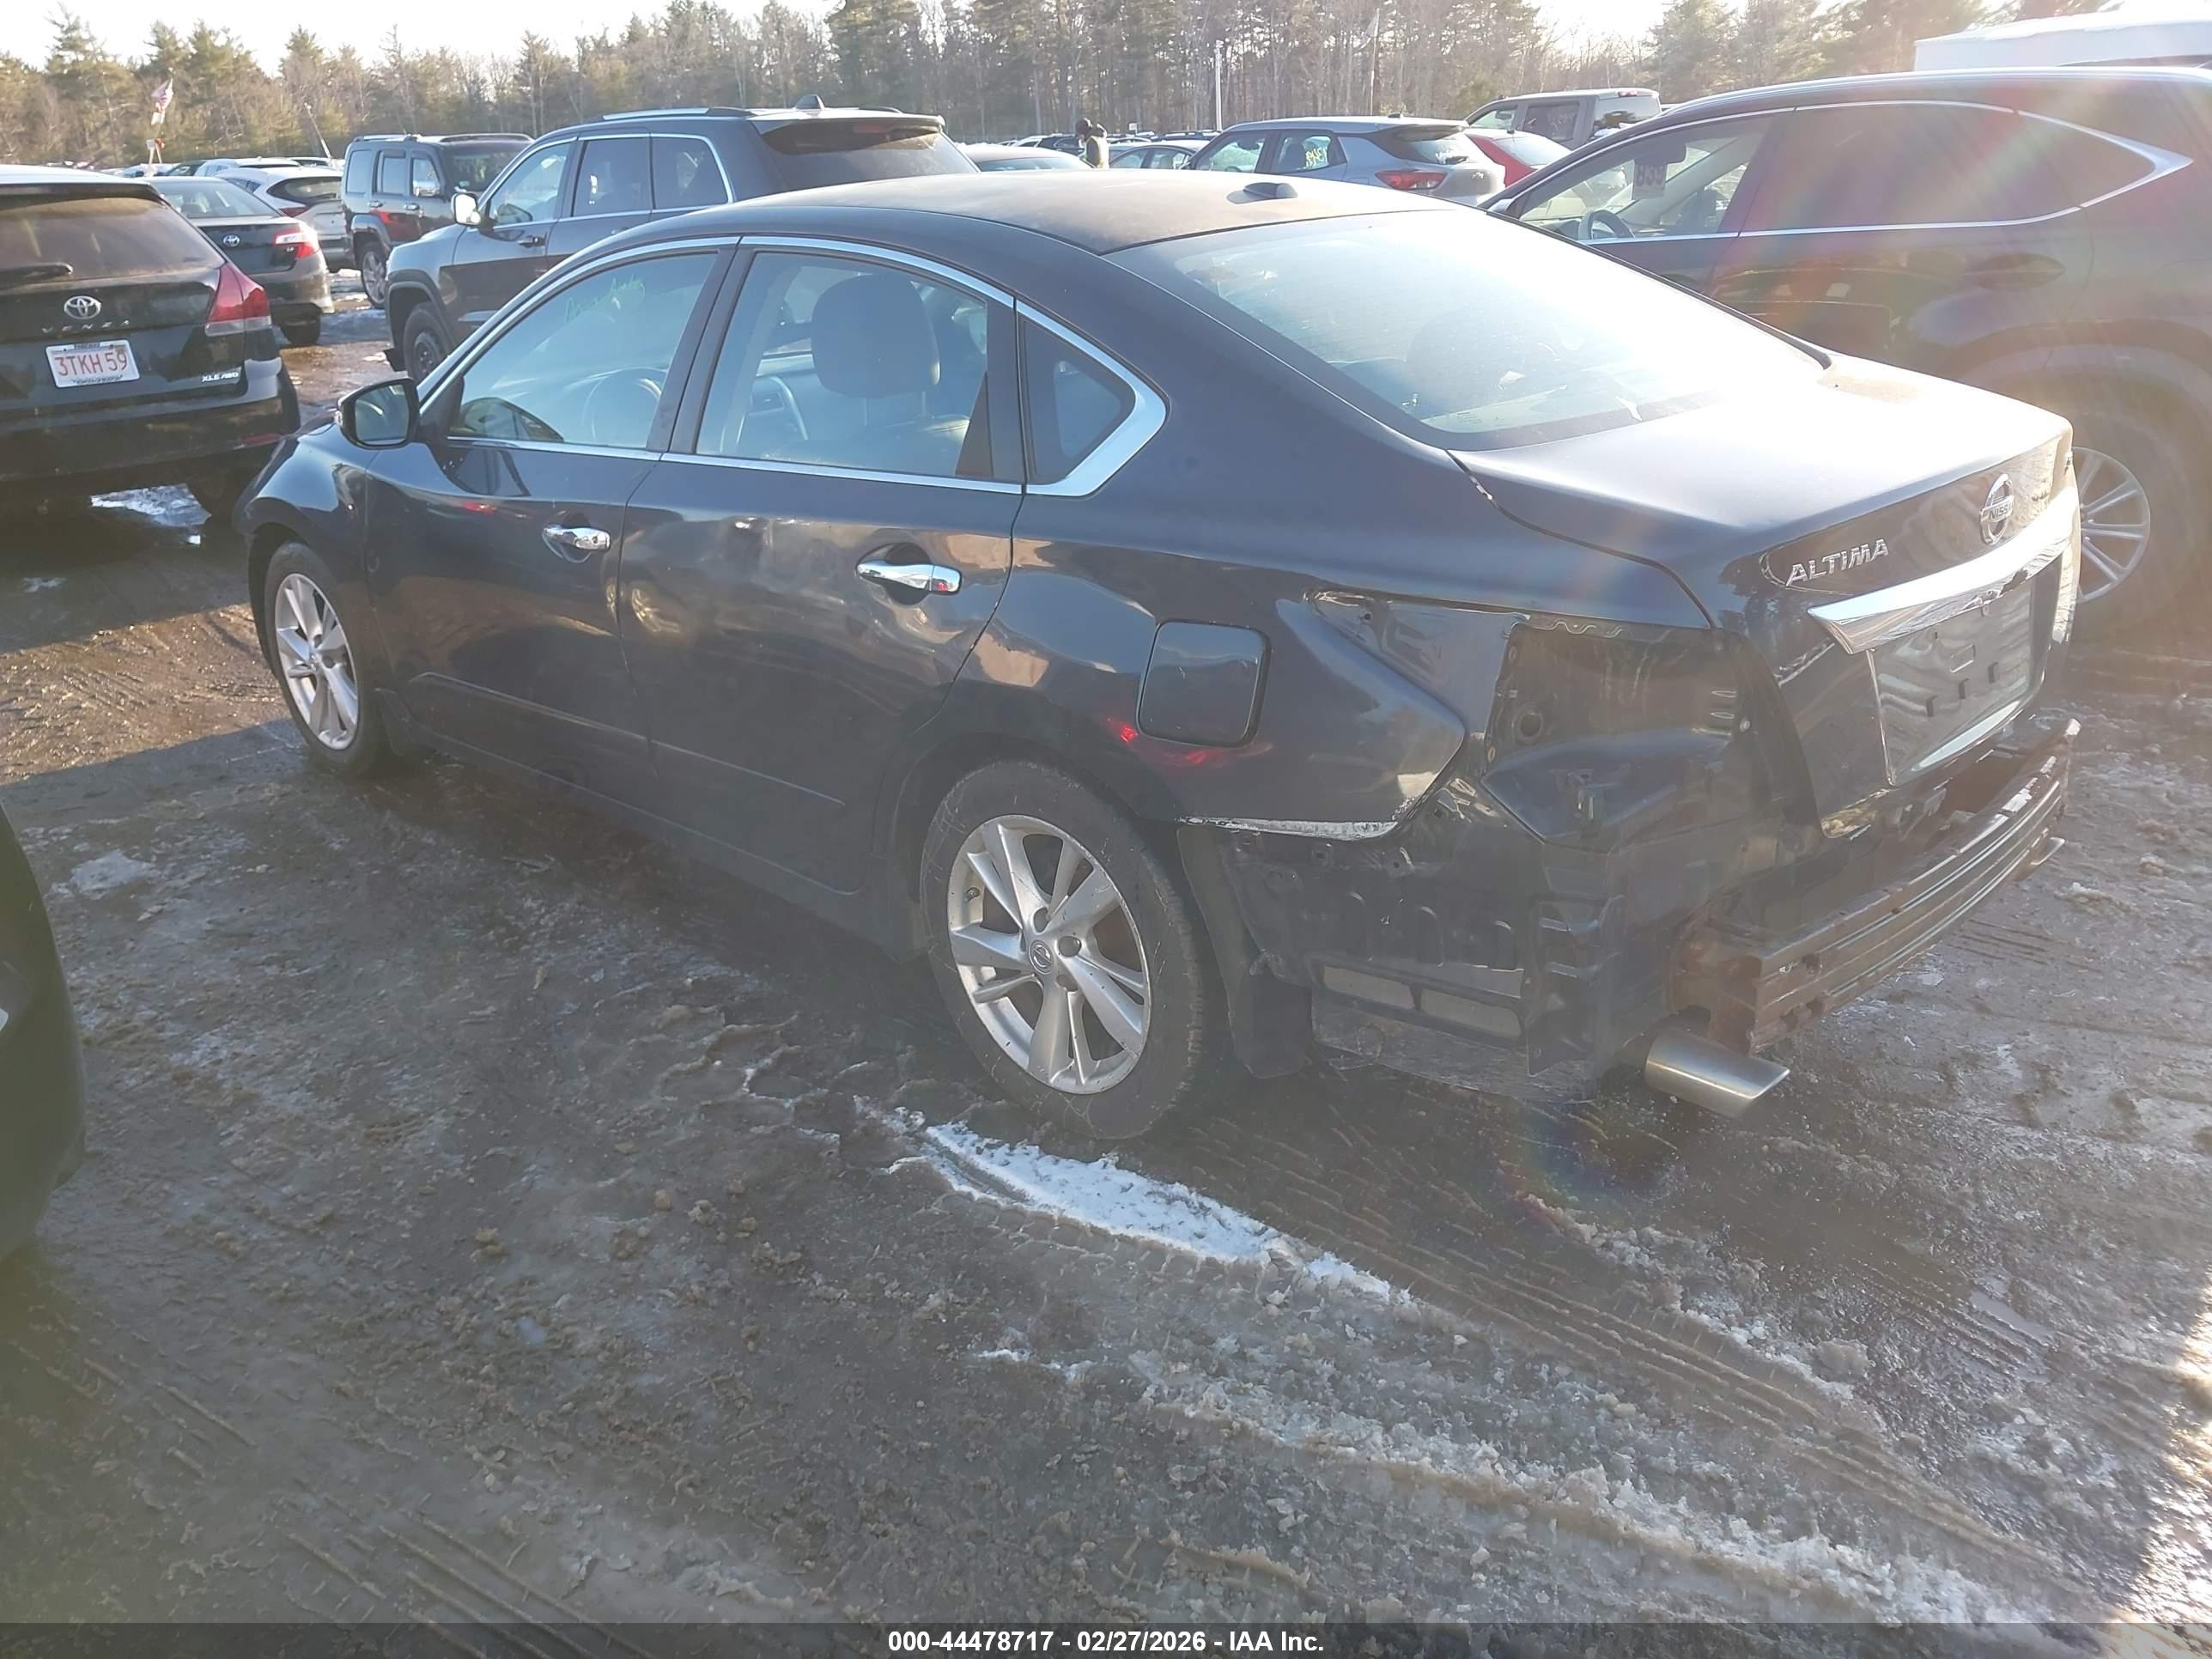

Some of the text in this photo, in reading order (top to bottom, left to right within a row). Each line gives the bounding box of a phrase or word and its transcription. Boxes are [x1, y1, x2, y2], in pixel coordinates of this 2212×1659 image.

[54, 351, 128, 376] 3TKH 59
[1785, 538, 1890, 586] ALTIMA
